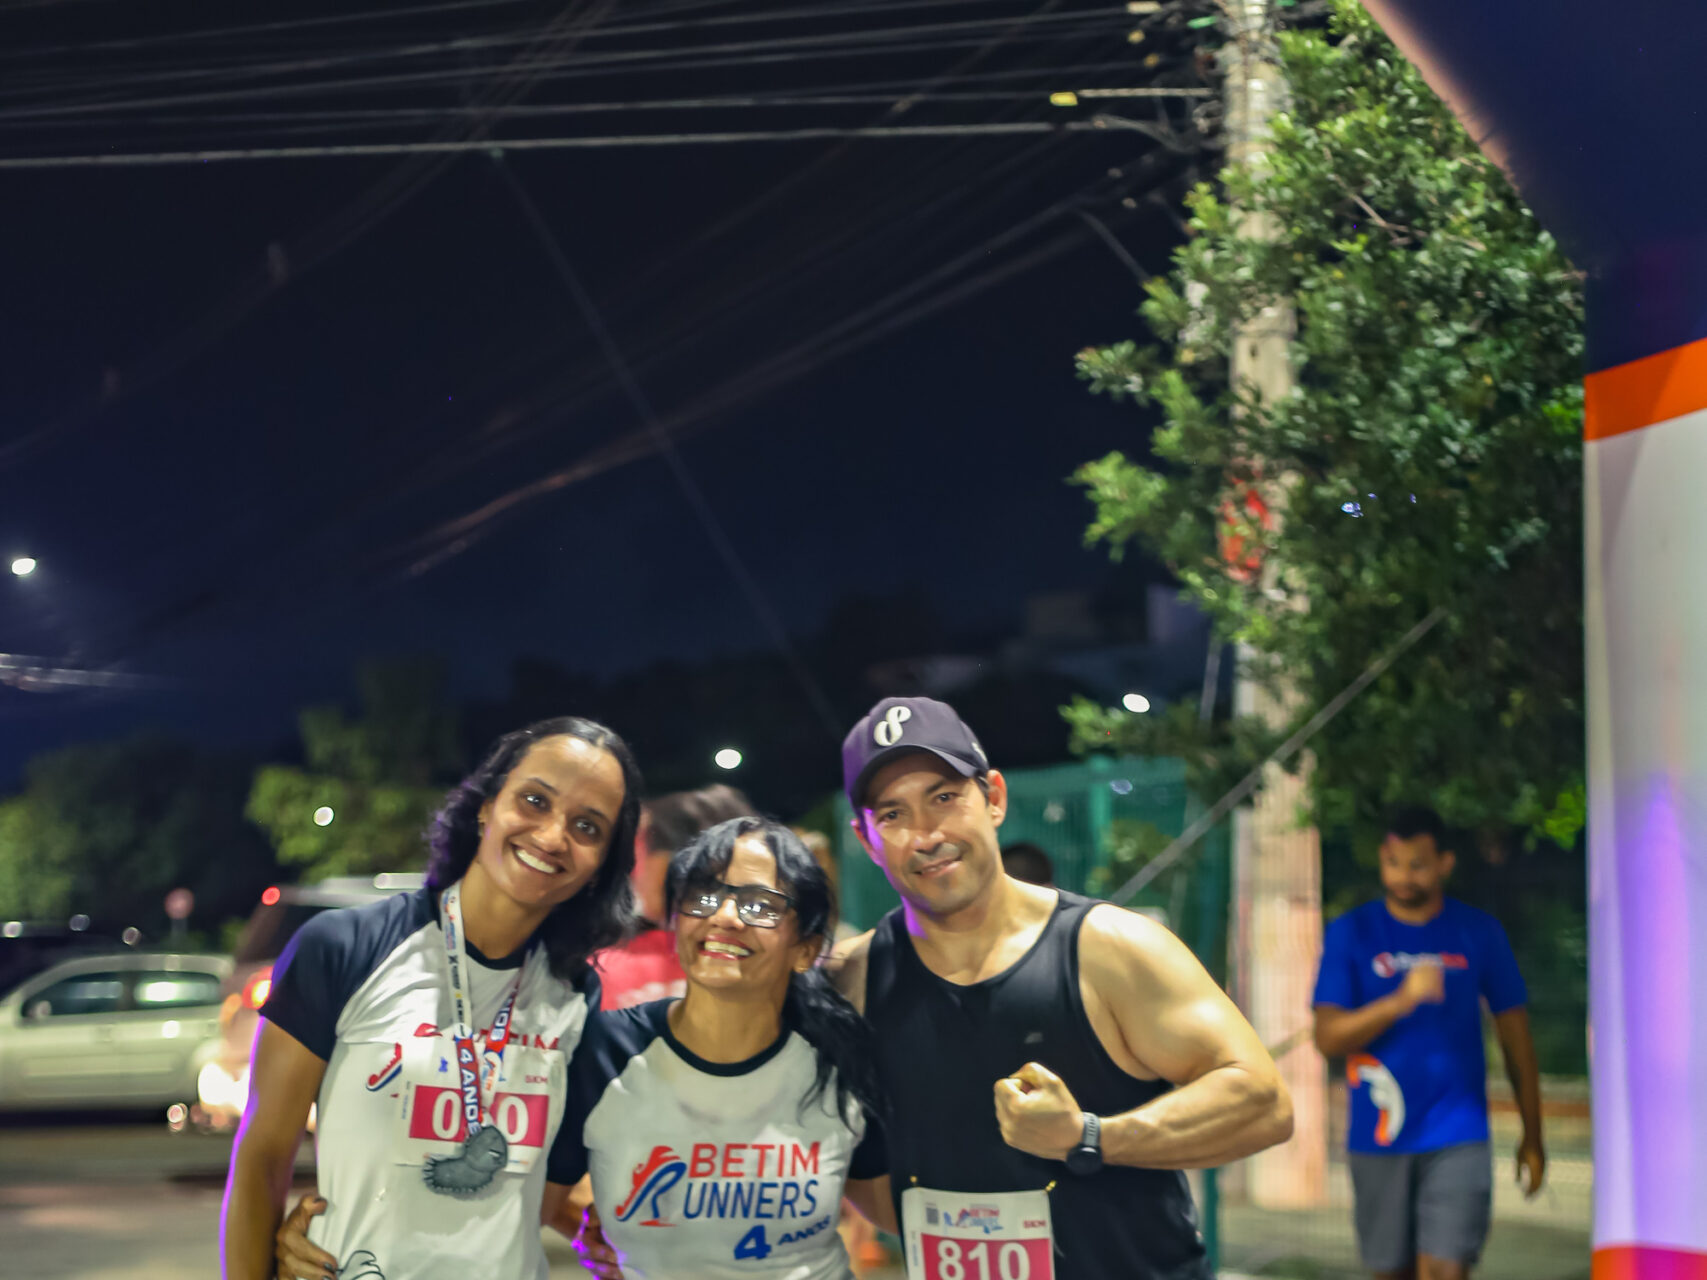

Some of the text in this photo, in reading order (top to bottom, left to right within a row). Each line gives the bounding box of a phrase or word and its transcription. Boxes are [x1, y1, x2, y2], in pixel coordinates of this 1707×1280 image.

[432, 1090, 529, 1143] 00
[688, 1141, 820, 1178] BETIM
[734, 1225, 772, 1260] 4
